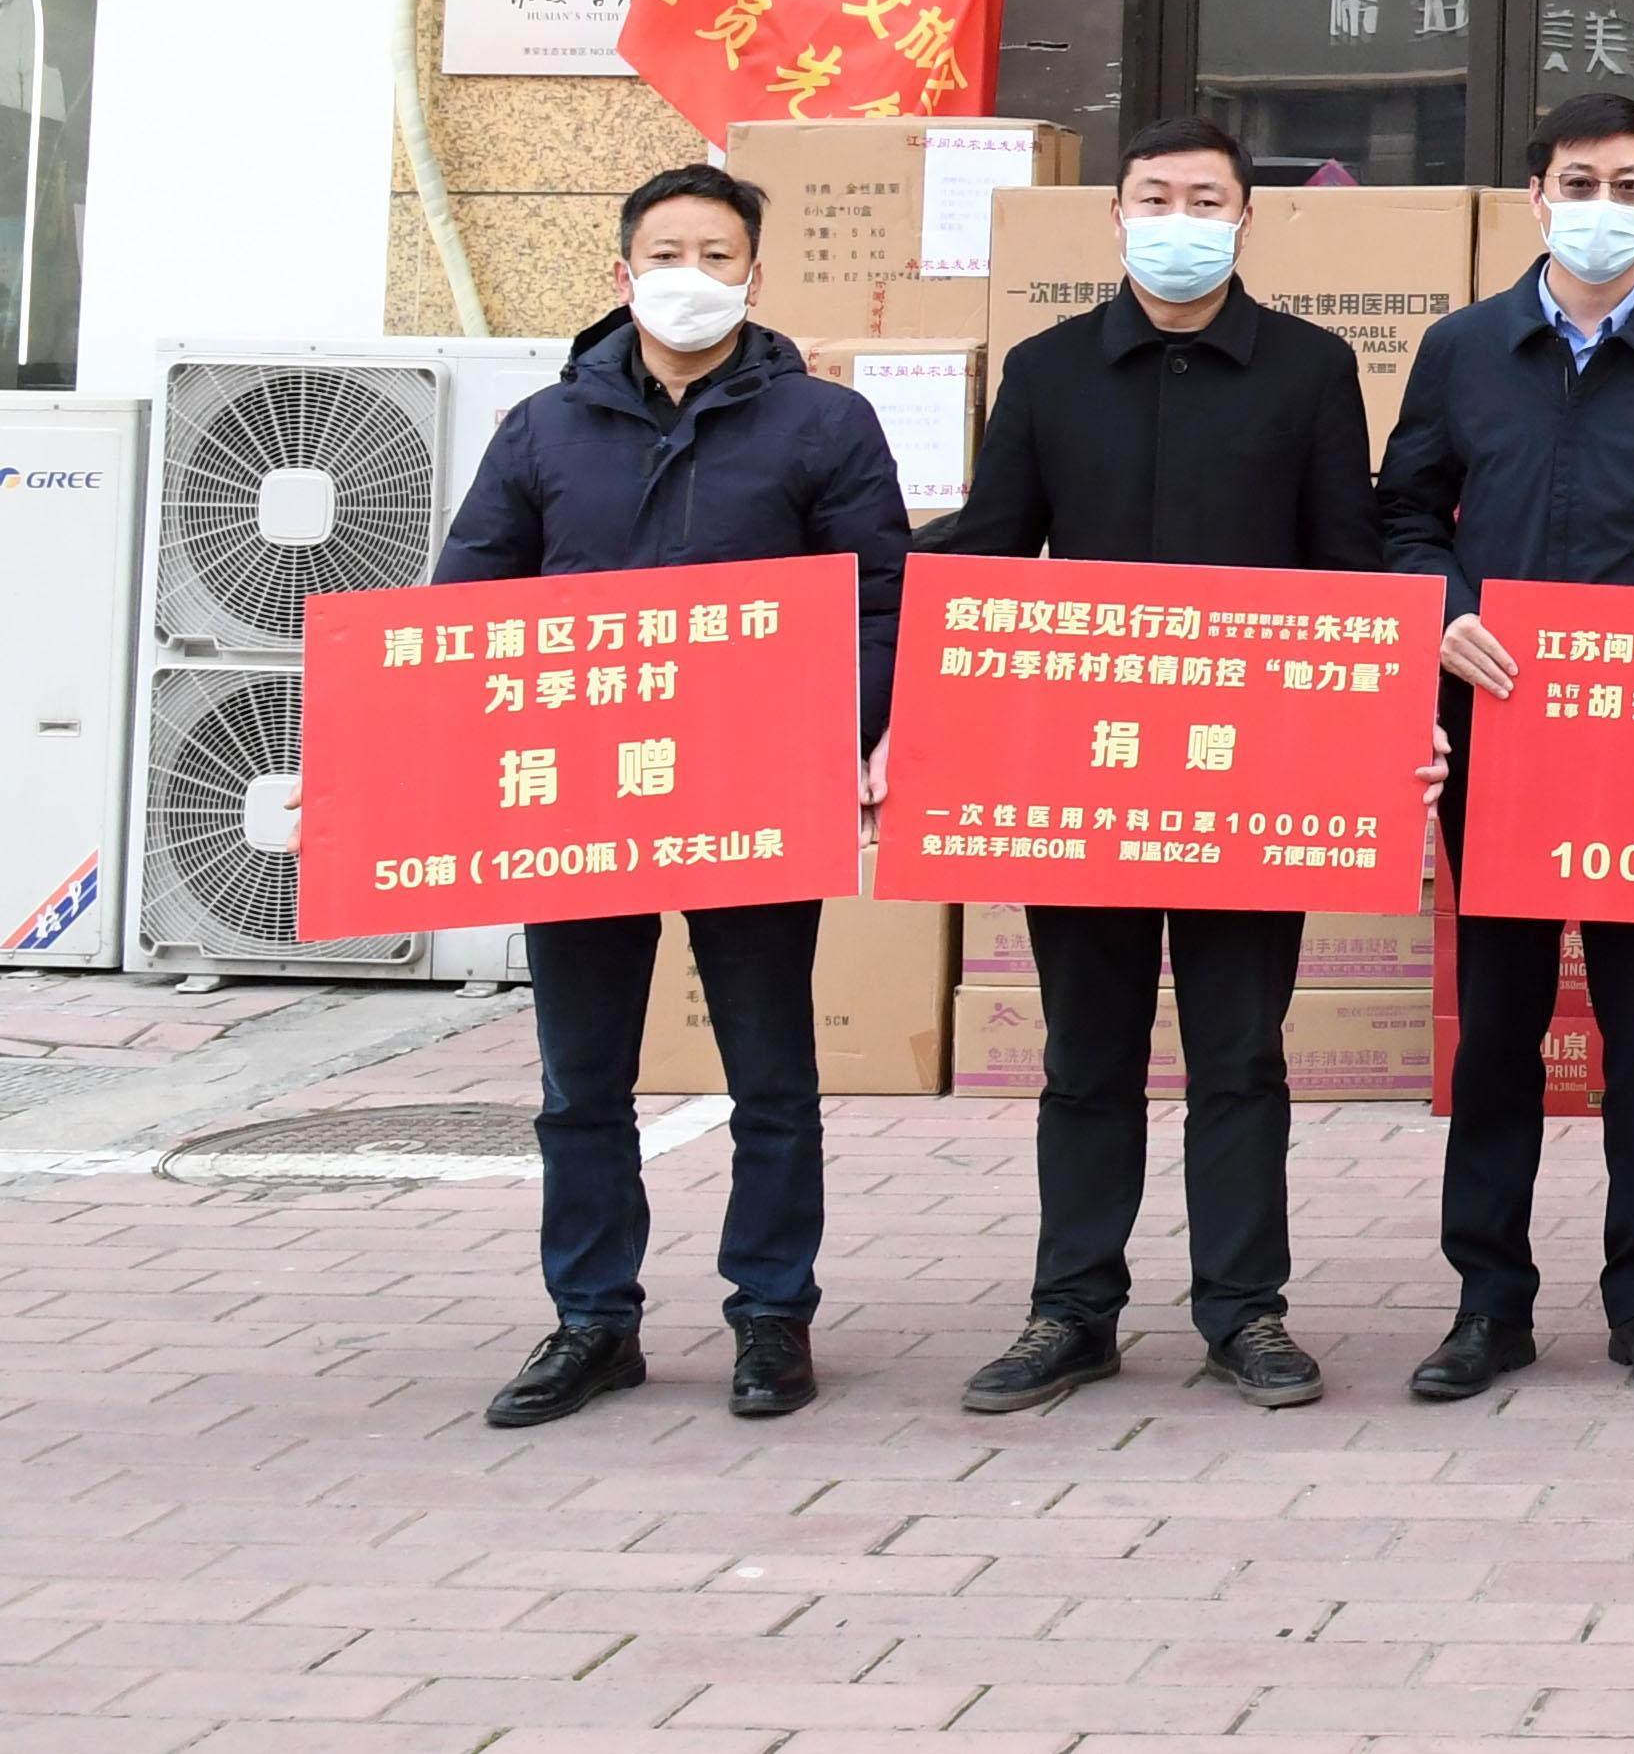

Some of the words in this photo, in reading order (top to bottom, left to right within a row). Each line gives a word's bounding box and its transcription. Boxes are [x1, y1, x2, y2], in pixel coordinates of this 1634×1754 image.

[1361, 340, 1408, 354] MASK
[26, 471, 103, 489] GREE
[383, 599, 781, 668] 清江浦区万和超市
[944, 596, 1201, 640] 疫情攻坚见行动
[1313, 614, 1400, 645] 朱华林
[485, 661, 679, 713] 为季桥村
[924, 803, 1378, 839] 一次性医用外科口罩10000只
[920, 834, 1087, 861] 免洗洗手液60瓶
[1118, 840, 1221, 864] 测温仪2台
[1262, 844, 1377, 869] 方便面10箱
